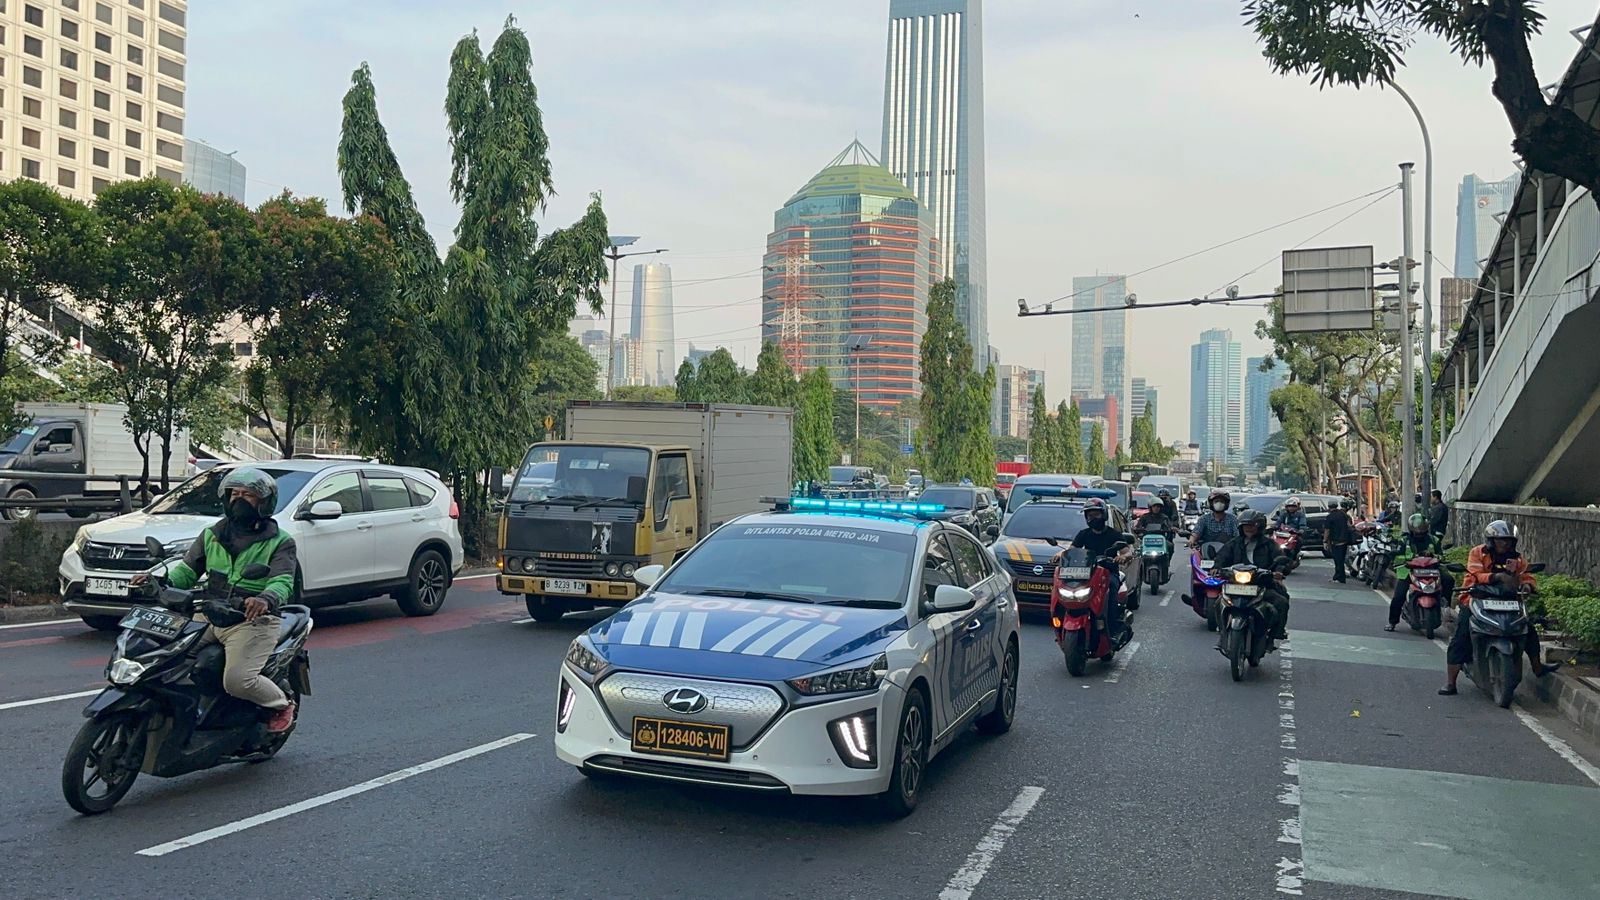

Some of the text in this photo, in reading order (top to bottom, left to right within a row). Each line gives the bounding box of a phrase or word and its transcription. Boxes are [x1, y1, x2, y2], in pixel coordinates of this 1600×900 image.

[744, 527, 880, 543] DITLANTAS POLDA METRO JAYA
[540, 552, 597, 560] MITSUBISHI
[95, 579, 113, 590] 1465
[546, 580, 550, 588] B
[554, 580, 570, 589] 9239
[132, 609, 140, 617] B
[142, 612, 164, 624] 4576
[652, 599, 845, 623] POLISI
[964, 631, 992, 674] POLISI
[661, 727, 724, 750] 128406-VII
